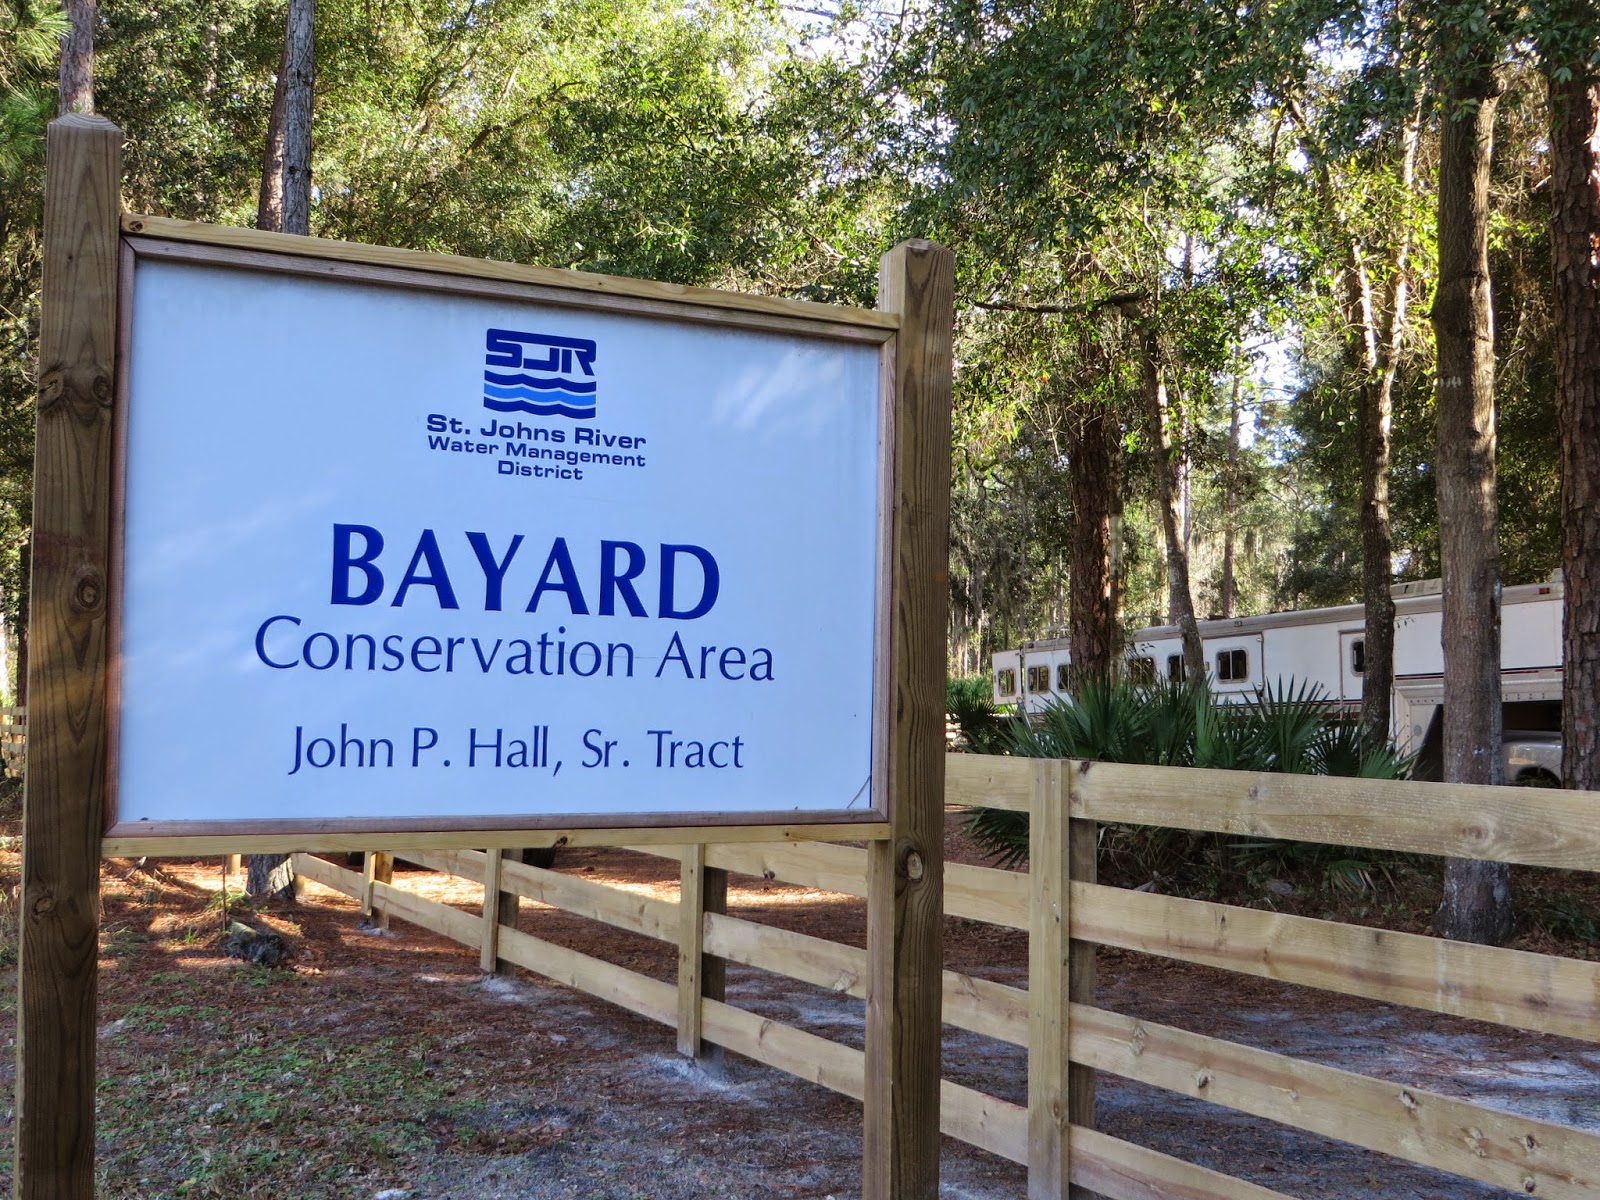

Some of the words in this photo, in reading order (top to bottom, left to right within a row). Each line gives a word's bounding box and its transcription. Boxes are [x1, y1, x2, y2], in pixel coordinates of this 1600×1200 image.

[427, 414, 471, 435] St.
[480, 419, 566, 444] Johns
[574, 427, 647, 450] River
[428, 435, 500, 455] Water
[506, 442, 646, 468] Management
[498, 460, 584, 481] District
[330, 523, 721, 621] BAYARD
[255, 615, 635, 678] Conservation
[655, 631, 776, 682] Area
[287, 723, 394, 776] John
[412, 727, 451, 768] P.
[469, 724, 563, 778] Hall,
[582, 729, 630, 769] Sr.
[647, 730, 745, 769] Tract
